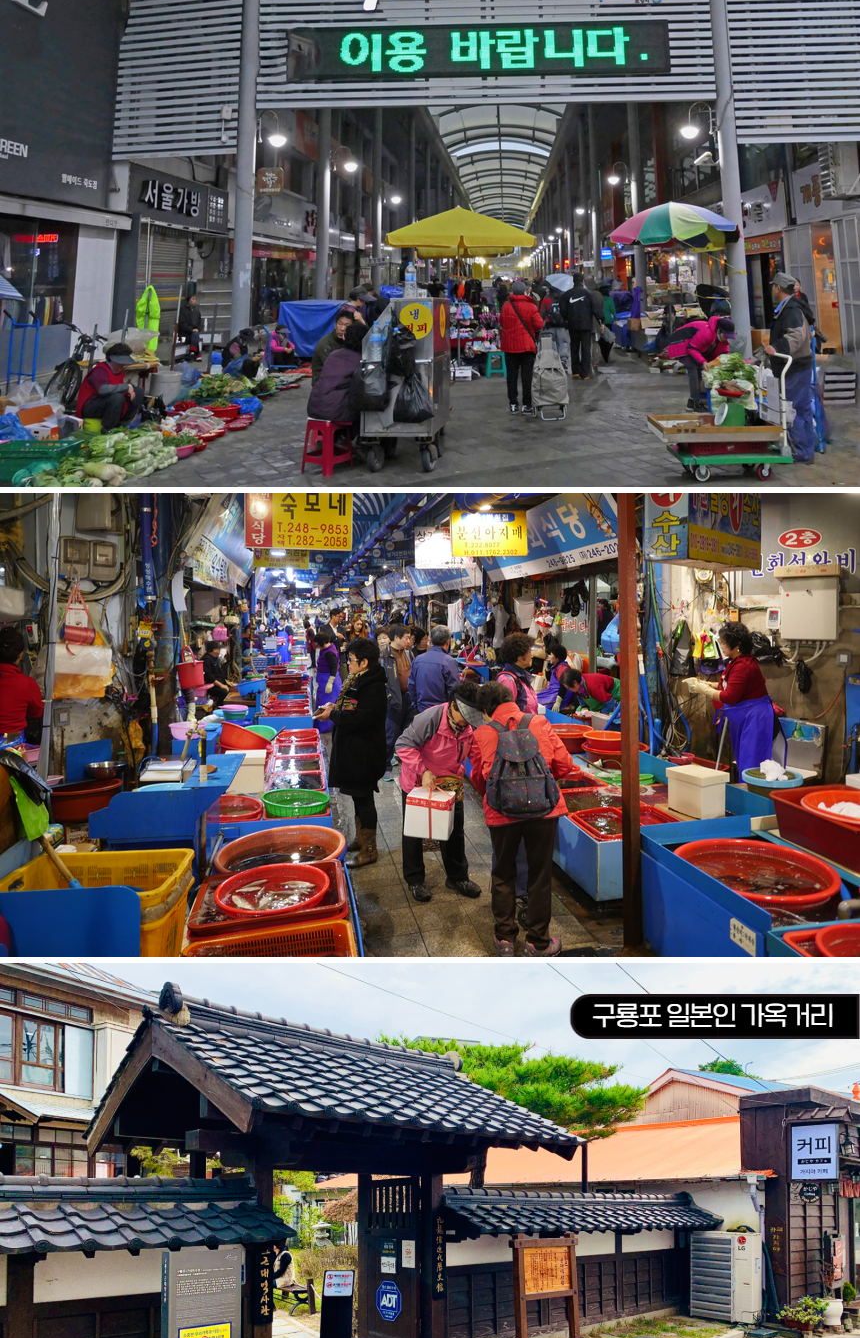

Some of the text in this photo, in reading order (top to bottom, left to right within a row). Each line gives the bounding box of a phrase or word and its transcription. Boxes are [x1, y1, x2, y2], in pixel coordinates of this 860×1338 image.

[340, 26, 649, 72] 이용 바랍니다.
[143, 179, 202, 218] 서울가방
[409, 308, 420, 320] 냉
[276, 521, 350, 536] T.248-9853
[651, 510, 681, 557] 수산
[287, 534, 349, 548] T.282-2058
[785, 531, 817, 545] 2층
[797, 1136, 831, 1155] 커피
[380, 1293, 398, 1309] ADT
